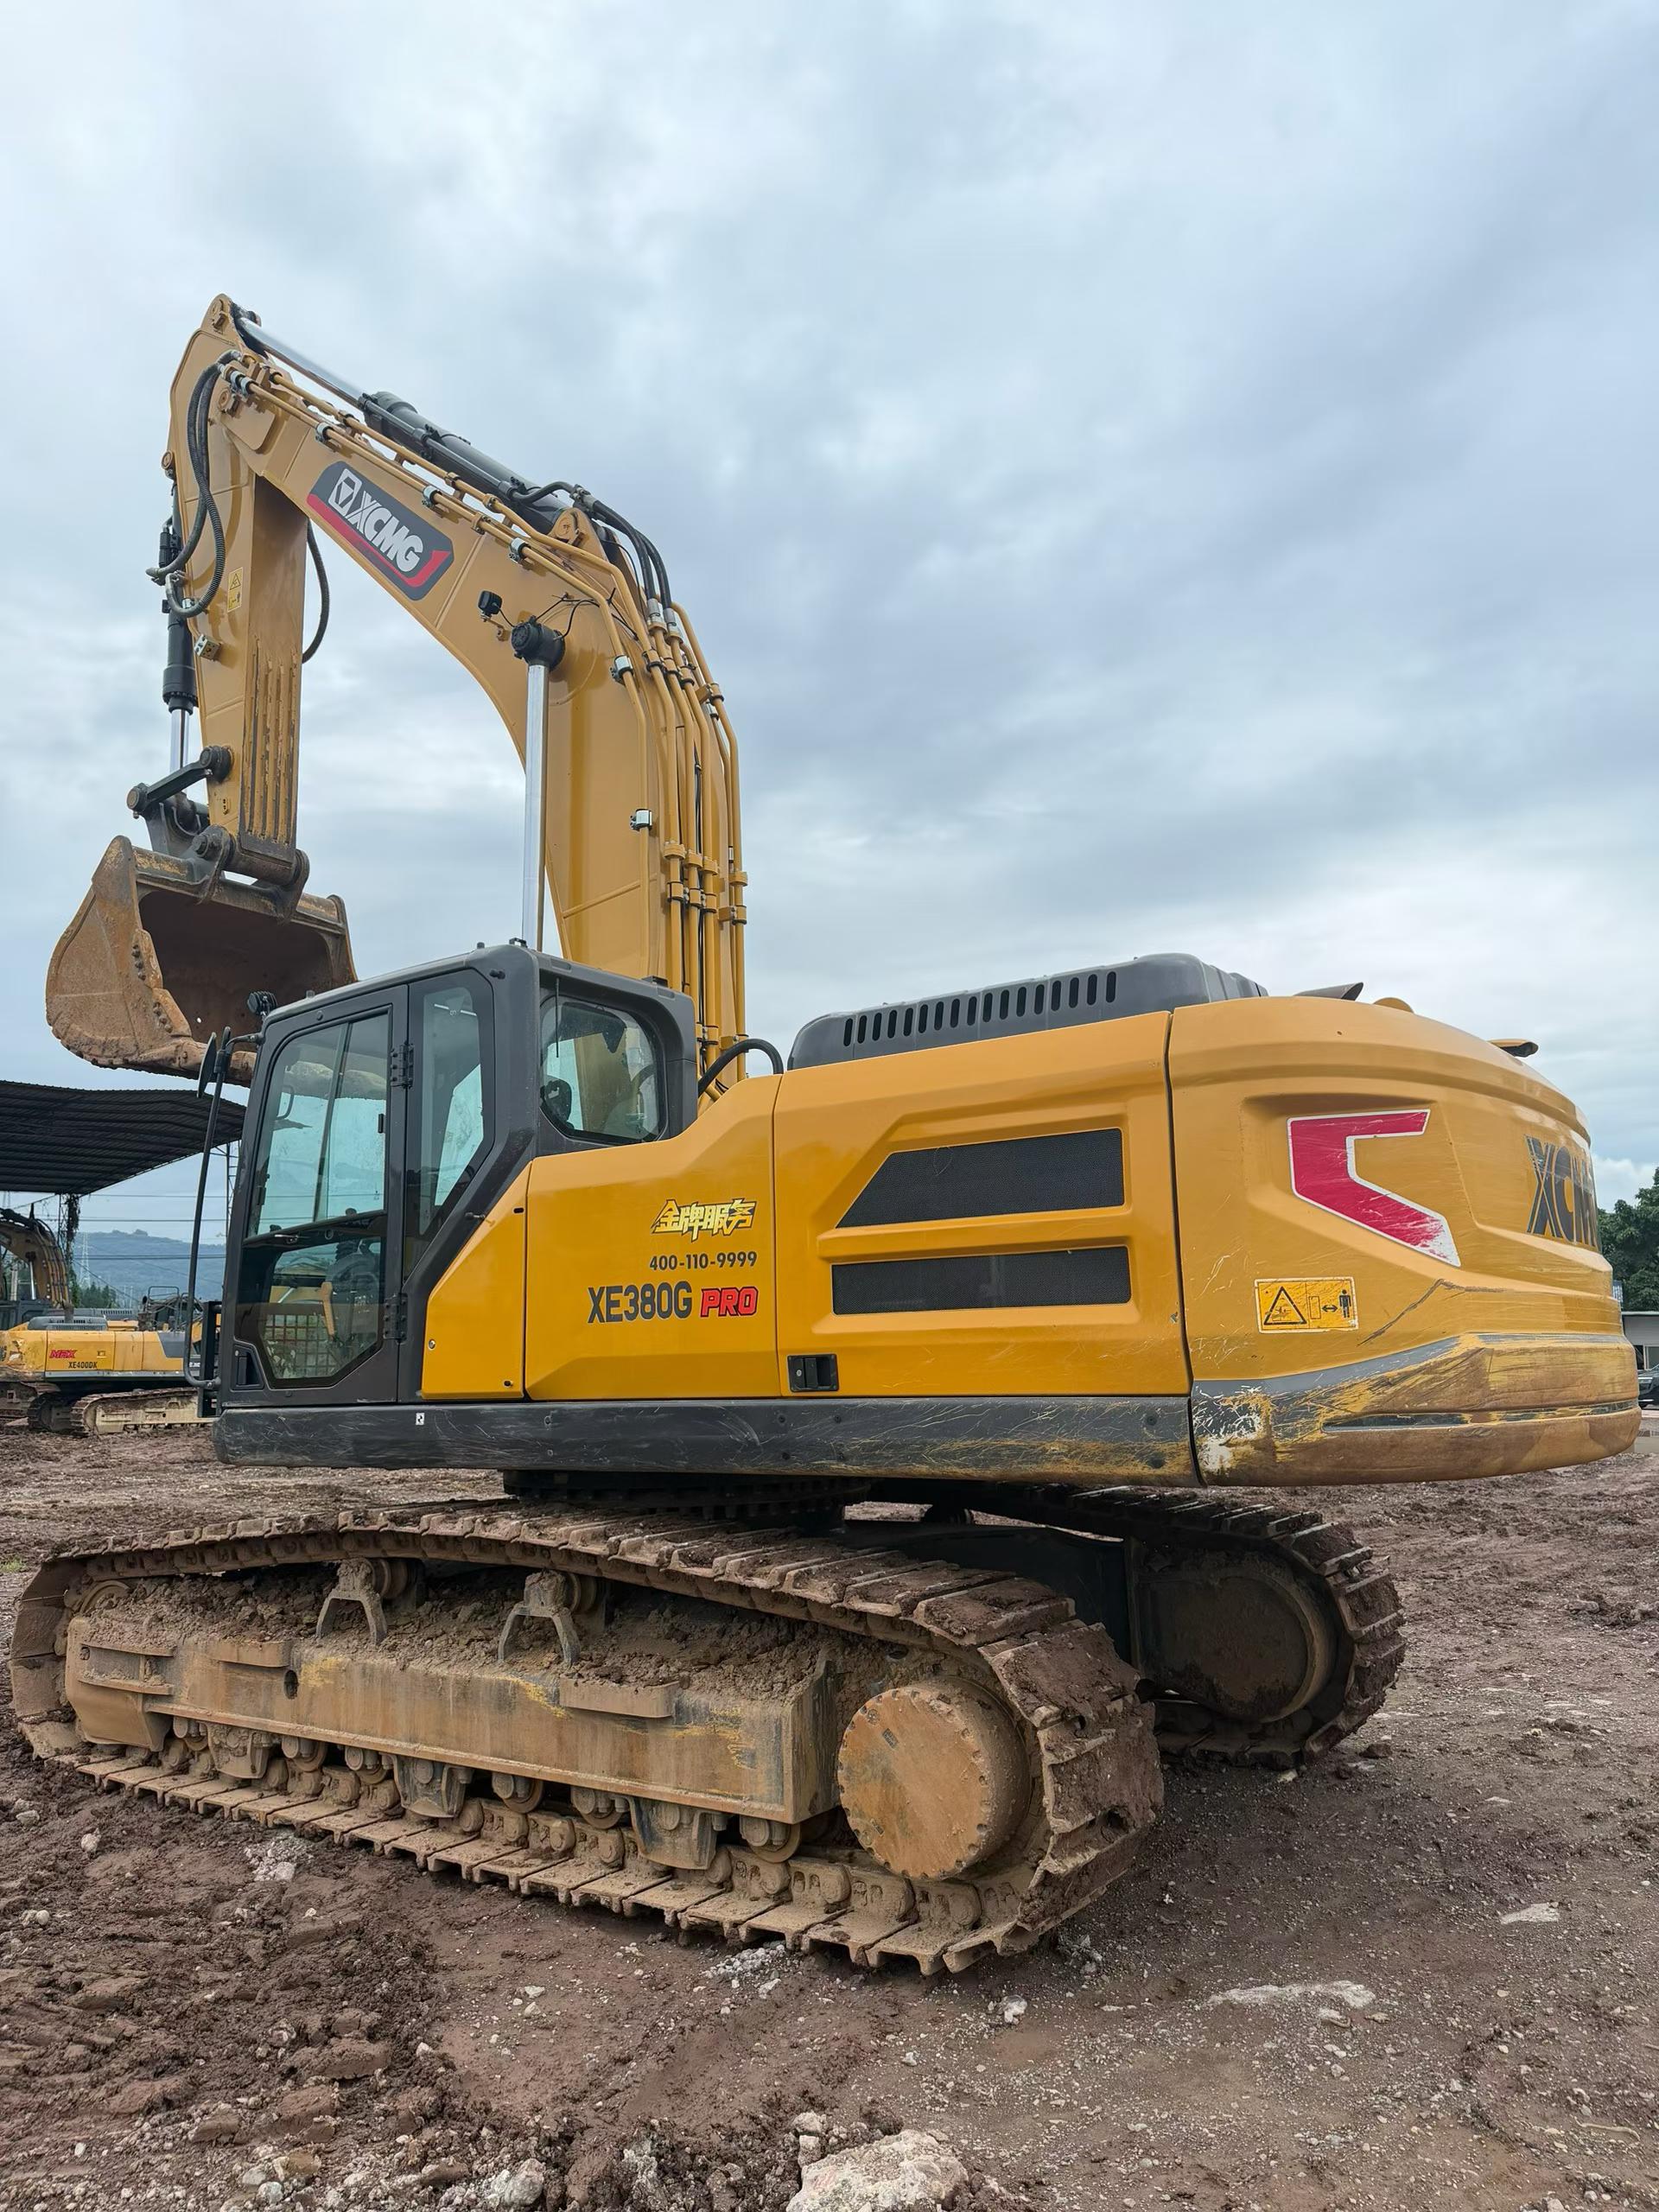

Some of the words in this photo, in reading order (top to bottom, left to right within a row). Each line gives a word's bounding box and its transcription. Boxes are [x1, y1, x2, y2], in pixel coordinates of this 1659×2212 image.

[345, 490, 423, 572] XCMG
[1526, 1135, 1598, 1249] XCM
[651, 1198, 757, 1242] 金牌服务
[650, 1251, 757, 1270] 400-110-9999
[588, 1281, 692, 1323] XE380G
[701, 1287, 759, 1318] PRO
